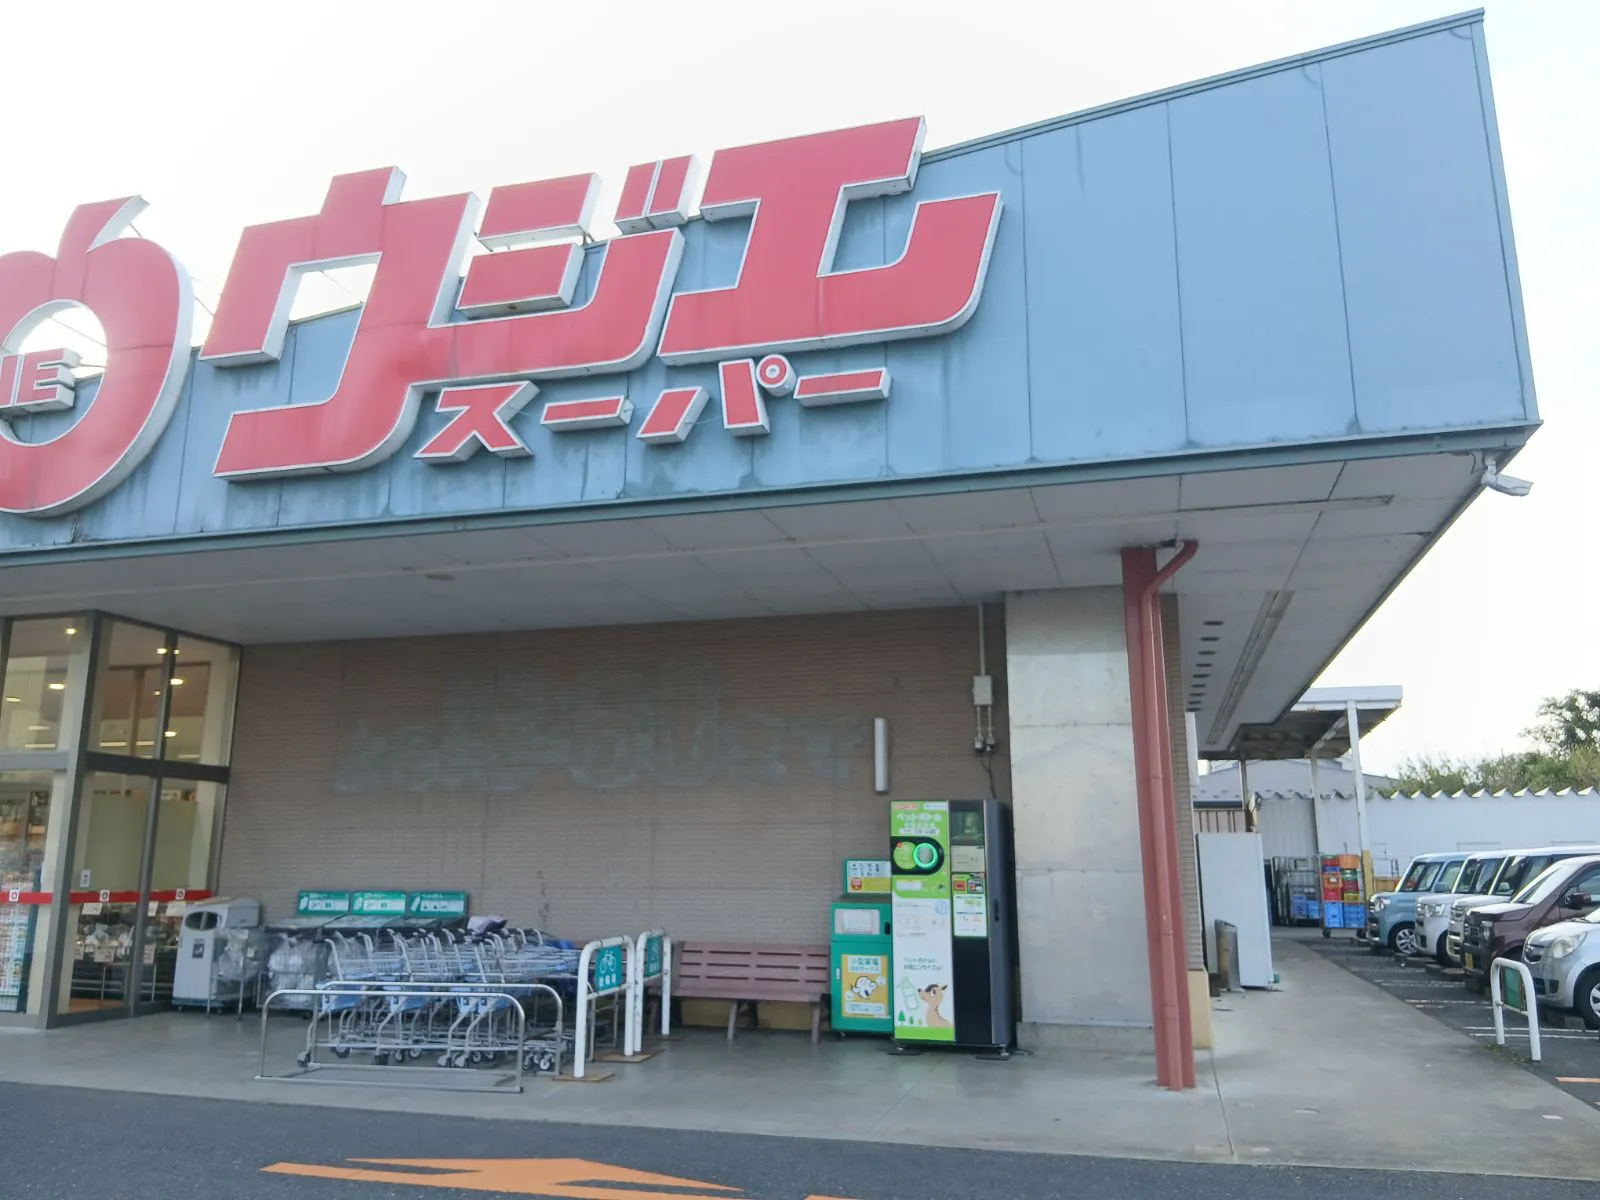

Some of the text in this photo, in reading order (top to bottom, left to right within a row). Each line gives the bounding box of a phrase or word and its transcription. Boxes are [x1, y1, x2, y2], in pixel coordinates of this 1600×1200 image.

[198, 115, 1004, 480] ウジエ
[413, 354, 890, 464] スーパー
